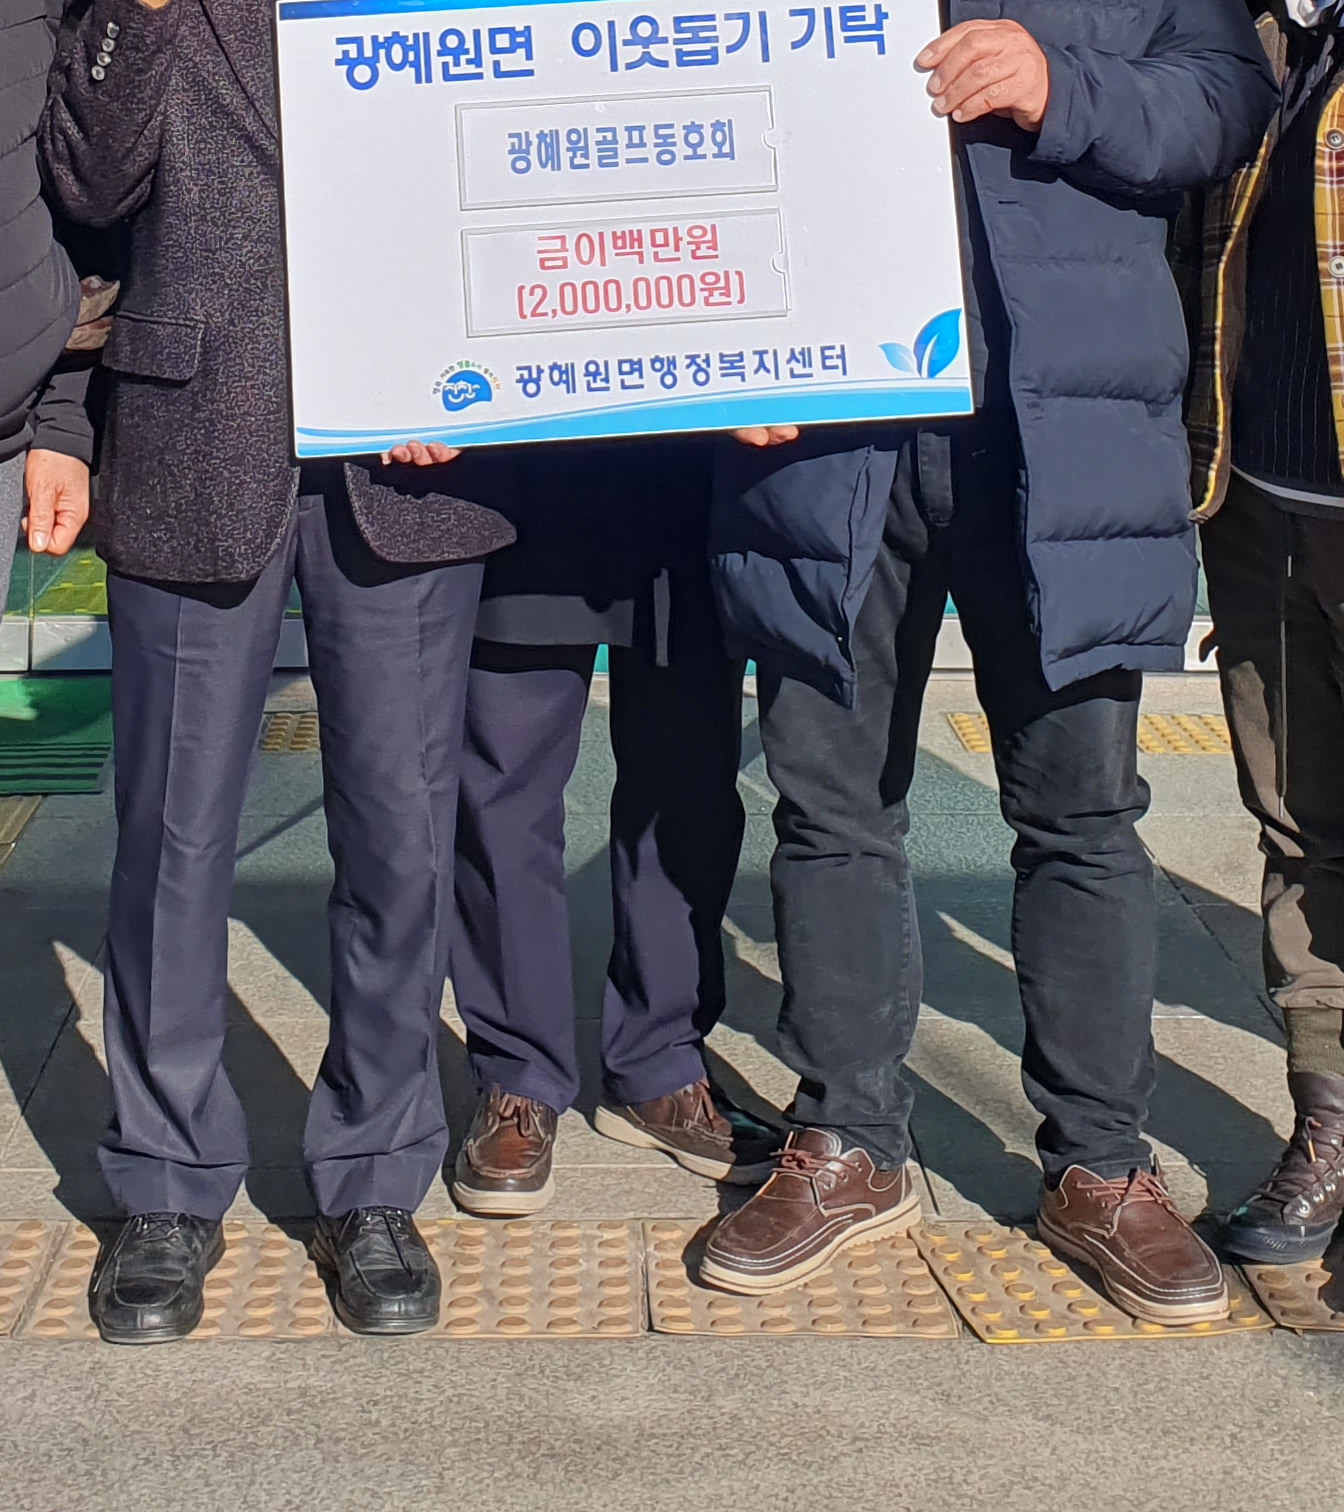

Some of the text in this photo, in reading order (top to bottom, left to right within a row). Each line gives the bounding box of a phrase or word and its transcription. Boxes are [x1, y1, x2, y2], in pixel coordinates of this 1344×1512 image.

[335, 3, 890, 90] 광혜원면 이웃돕기 기탁
[506, 118, 736, 176] 광혜원골프동호회
[536, 223, 720, 271] 금이백만원
[516, 270, 746, 320] (2,000,000원)
[515, 344, 849, 399] 광혜원면행정복지센터
